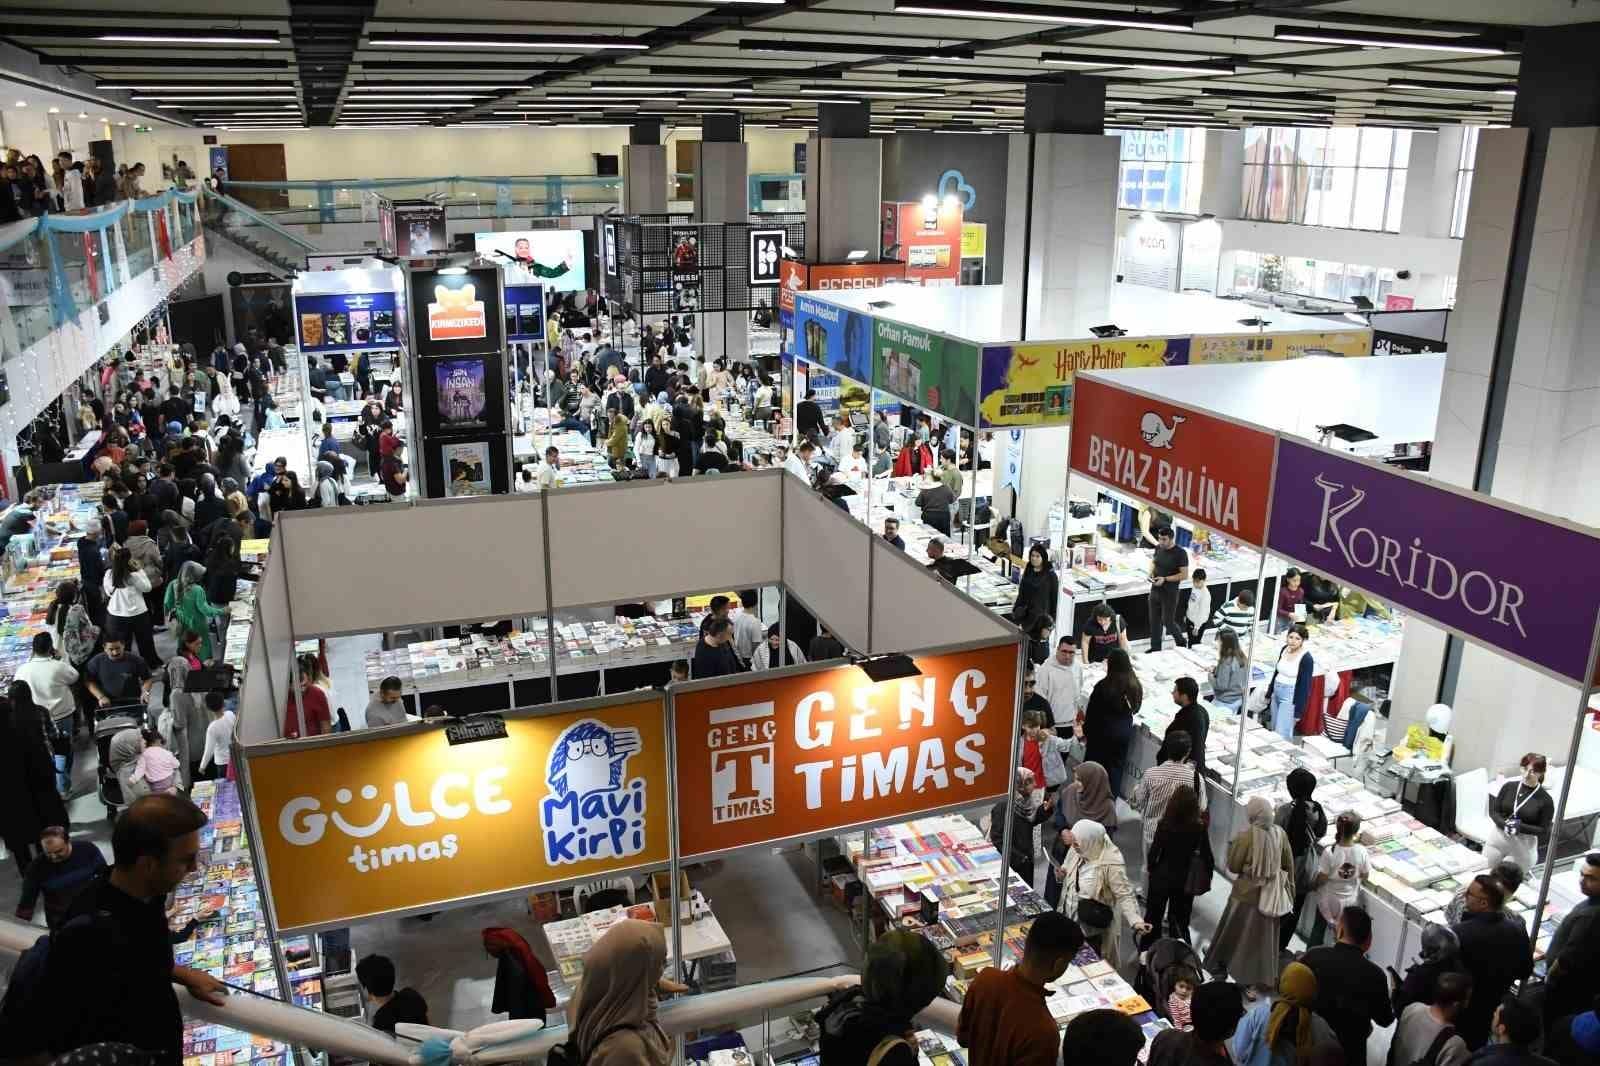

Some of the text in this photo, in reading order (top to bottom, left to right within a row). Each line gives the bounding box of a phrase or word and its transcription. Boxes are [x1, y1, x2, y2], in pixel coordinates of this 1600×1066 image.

[673, 274, 700, 282] MESSI
[800, 298, 839, 322] Amin Maalouf
[878, 323, 932, 352] Orhan Pamuk
[1055, 343, 1128, 380] Harry Potter
[1087, 434, 1240, 531] BEYAZ BALİNA
[1310, 471, 1528, 639] KORİDOR
[794, 668, 989, 750] GENÇ
[707, 720, 777, 749] GENÇ
[543, 780, 644, 827] Mavi
[347, 832, 459, 873] timaş
